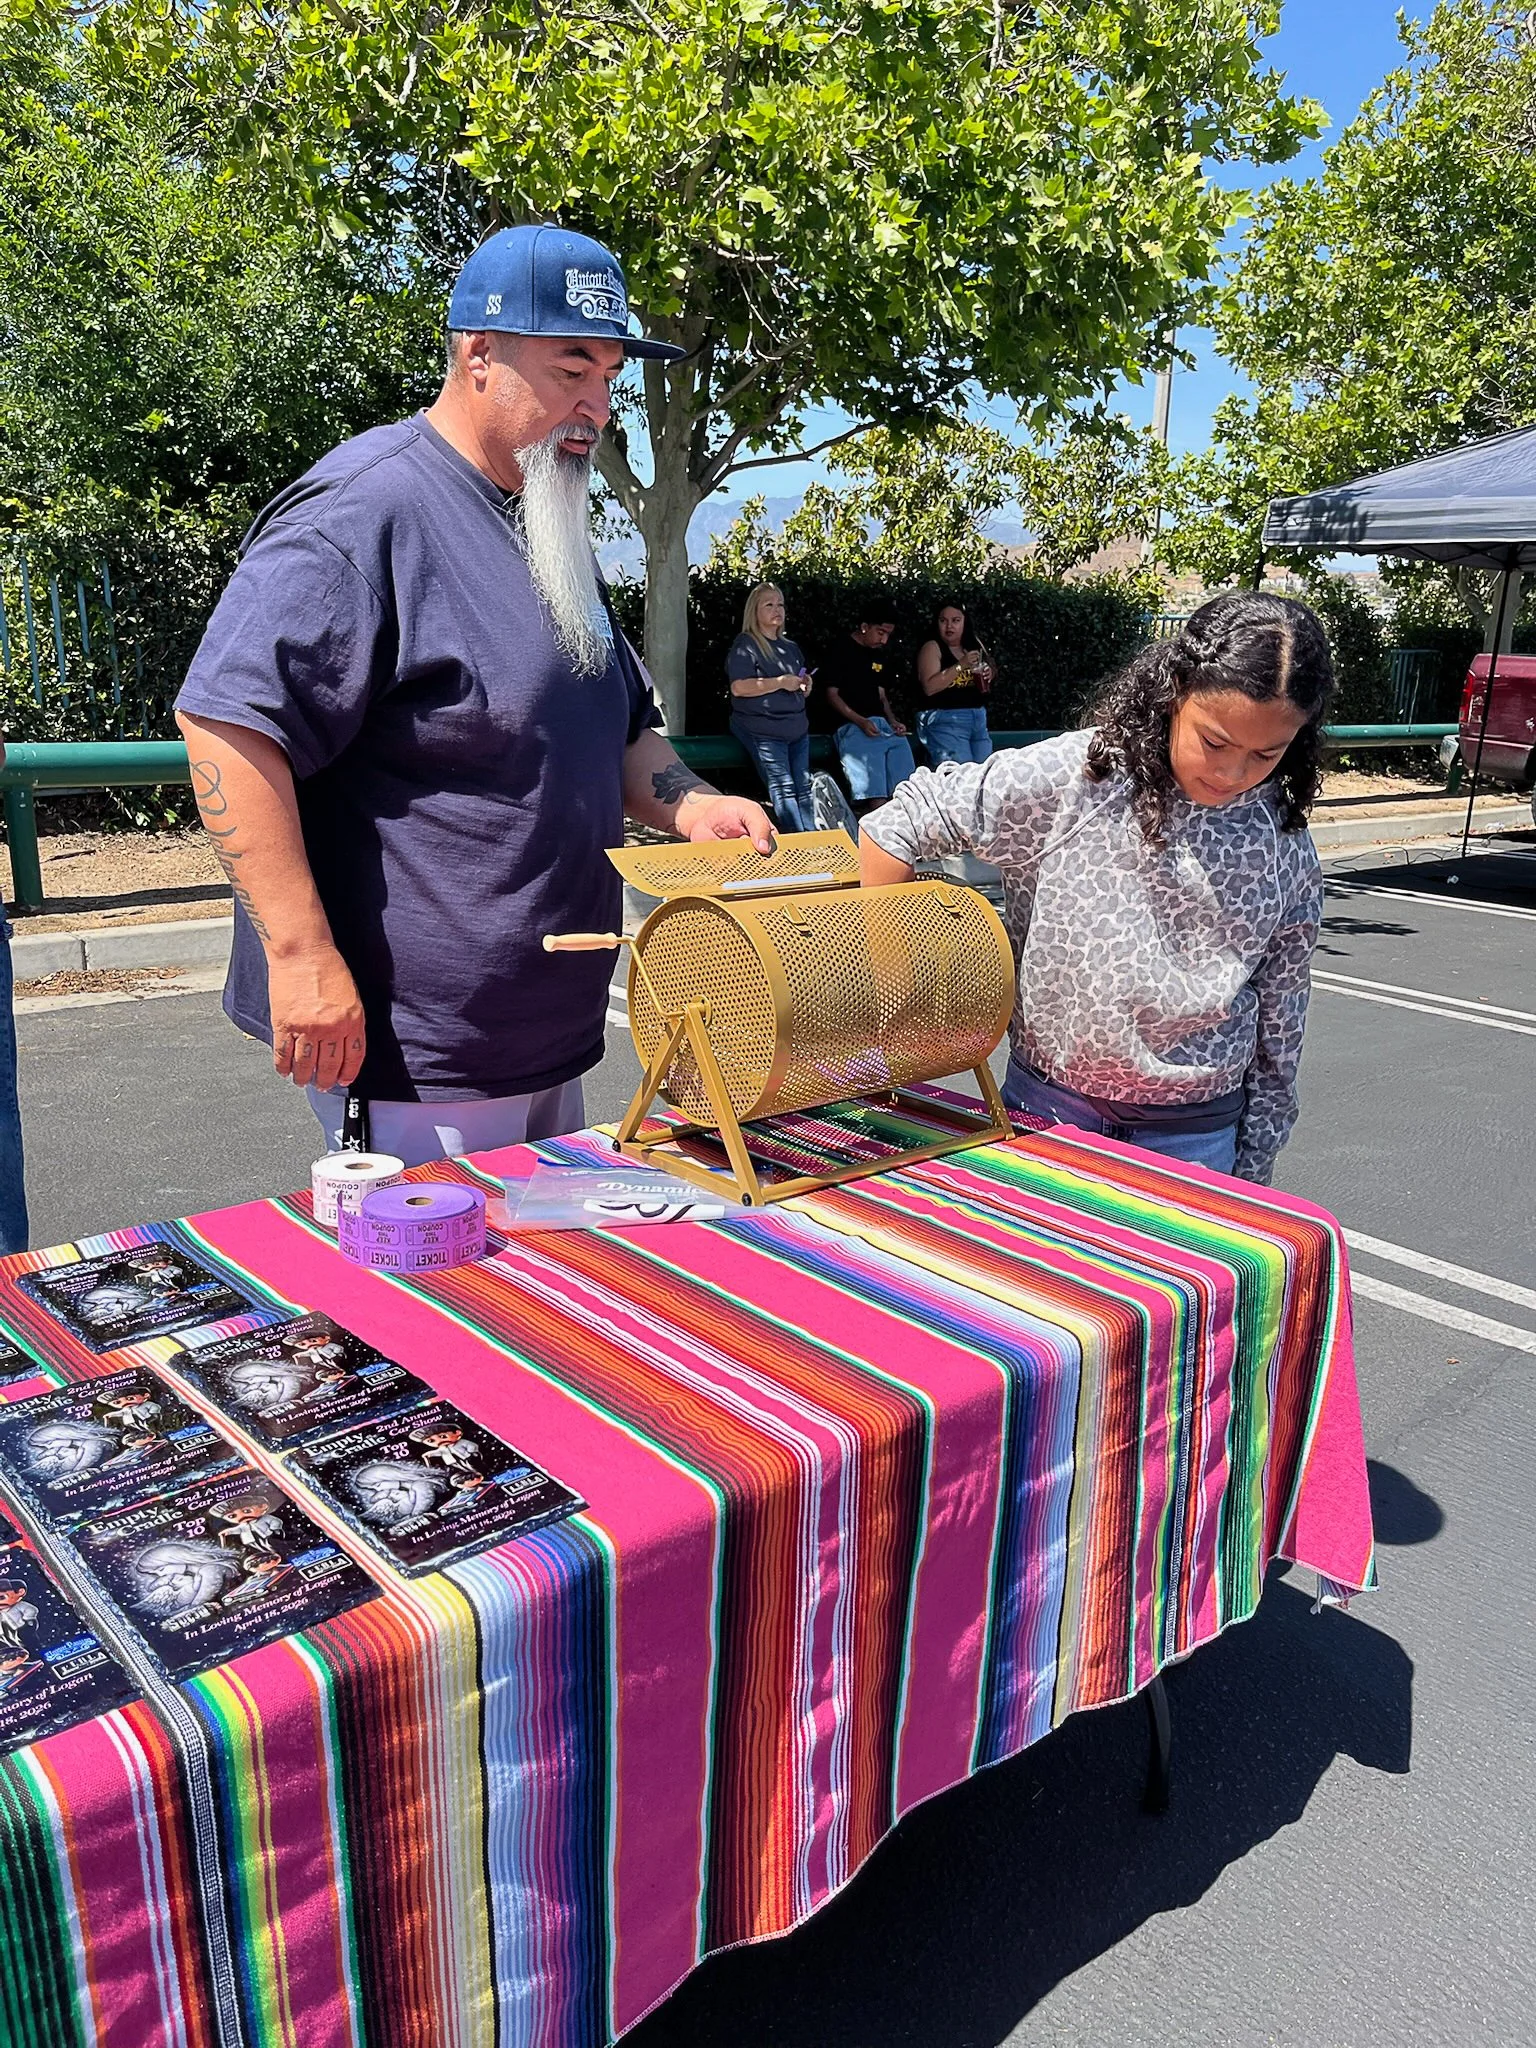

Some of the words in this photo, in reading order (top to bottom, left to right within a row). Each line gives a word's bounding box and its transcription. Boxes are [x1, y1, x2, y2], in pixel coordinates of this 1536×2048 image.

[485, 294, 502, 316] SS
[371, 1224, 396, 1232] COUPON
[418, 1224, 443, 1232] COUPON
[371, 1252, 399, 1267] TICKET
[416, 1252, 447, 1267] TICKET
[254, 1326, 275, 1339] 2nd
[276, 1317, 313, 1333] Annual
[265, 1331, 286, 1343] Car
[287, 1323, 314, 1337] Show
[188, 1338, 242, 1358] Empty
[255, 1344, 281, 1356] Top
[267, 1350, 282, 1360] 10
[67, 1383, 92, 1395] 2nd
[93, 1370, 138, 1388] Annual
[78, 1388, 102, 1399] Car
[103, 1378, 137, 1392] Show
[64, 1403, 93, 1415] Top
[75, 1410, 92, 1420] 10
[288, 1405, 320, 1421] Loving
[320, 1394, 357, 1411] Memory
[375, 1420, 400, 1434] 2nd
[400, 1406, 442, 1425] Annual
[388, 1425, 412, 1437] Car
[412, 1414, 443, 1431] Show
[303, 1431, 366, 1457] Empty
[331, 1435, 387, 1458] Cradle
[380, 1441, 408, 1455] Top
[393, 1448, 410, 1460] 10
[64, 1488, 78, 1498] In
[79, 1477, 117, 1494] Loving
[117, 1461, 162, 1481] Memory
[161, 1457, 173, 1466] of
[108, 1480, 134, 1492] April
[152, 1466, 177, 1478] 2026
[174, 1492, 202, 1507] 2nd
[204, 1476, 251, 1498] Annual
[187, 1498, 214, 1512] Car
[216, 1486, 250, 1502] Show
[88, 1505, 160, 1535] Empty
[117, 1510, 184, 1538] Cradle
[173, 1516, 206, 1532] Top
[412, 1534, 425, 1544] In
[459, 1505, 499, 1526] Memory
[498, 1500, 509, 1511] of
[454, 1523, 479, 1537] April
[187, 1526, 206, 1538] 10
[184, 1629, 200, 1641] In
[200, 1612, 242, 1634] Loving
[243, 1594, 291, 1618] Memory
[291, 1587, 304, 1599] of
[304, 1573, 342, 1593] Logan
[234, 1615, 262, 1632] April
[281, 1597, 309, 1613] 2026
[35, 1688, 48, 1702] of
[50, 1673, 94, 1694] Logan
[19, 1703, 52, 1719] 2026
